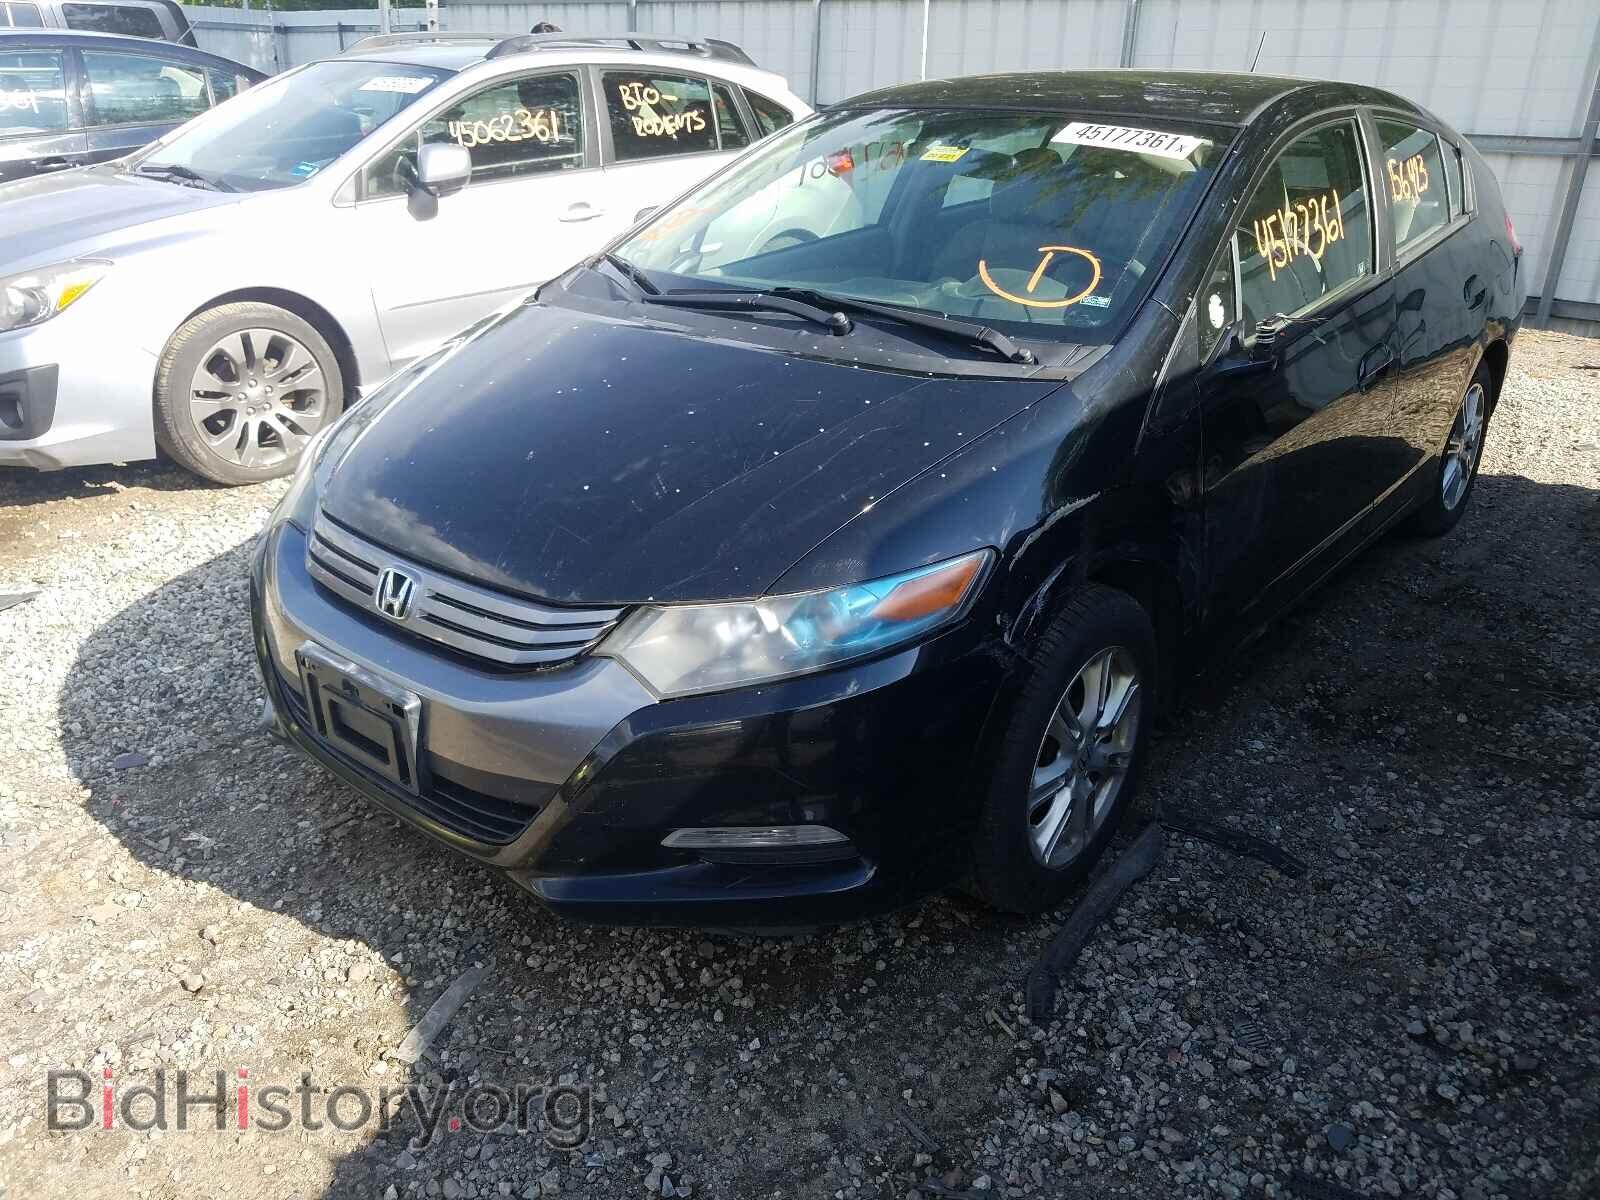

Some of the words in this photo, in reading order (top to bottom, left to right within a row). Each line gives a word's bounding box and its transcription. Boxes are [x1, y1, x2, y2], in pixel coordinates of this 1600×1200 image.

[619, 83, 678, 110] BIO-
[448, 109, 560, 148] 45062361
[631, 109, 706, 137] RODENTS
[1076, 125, 1180, 151] 45177361
[1254, 188, 1345, 281] 45177361
